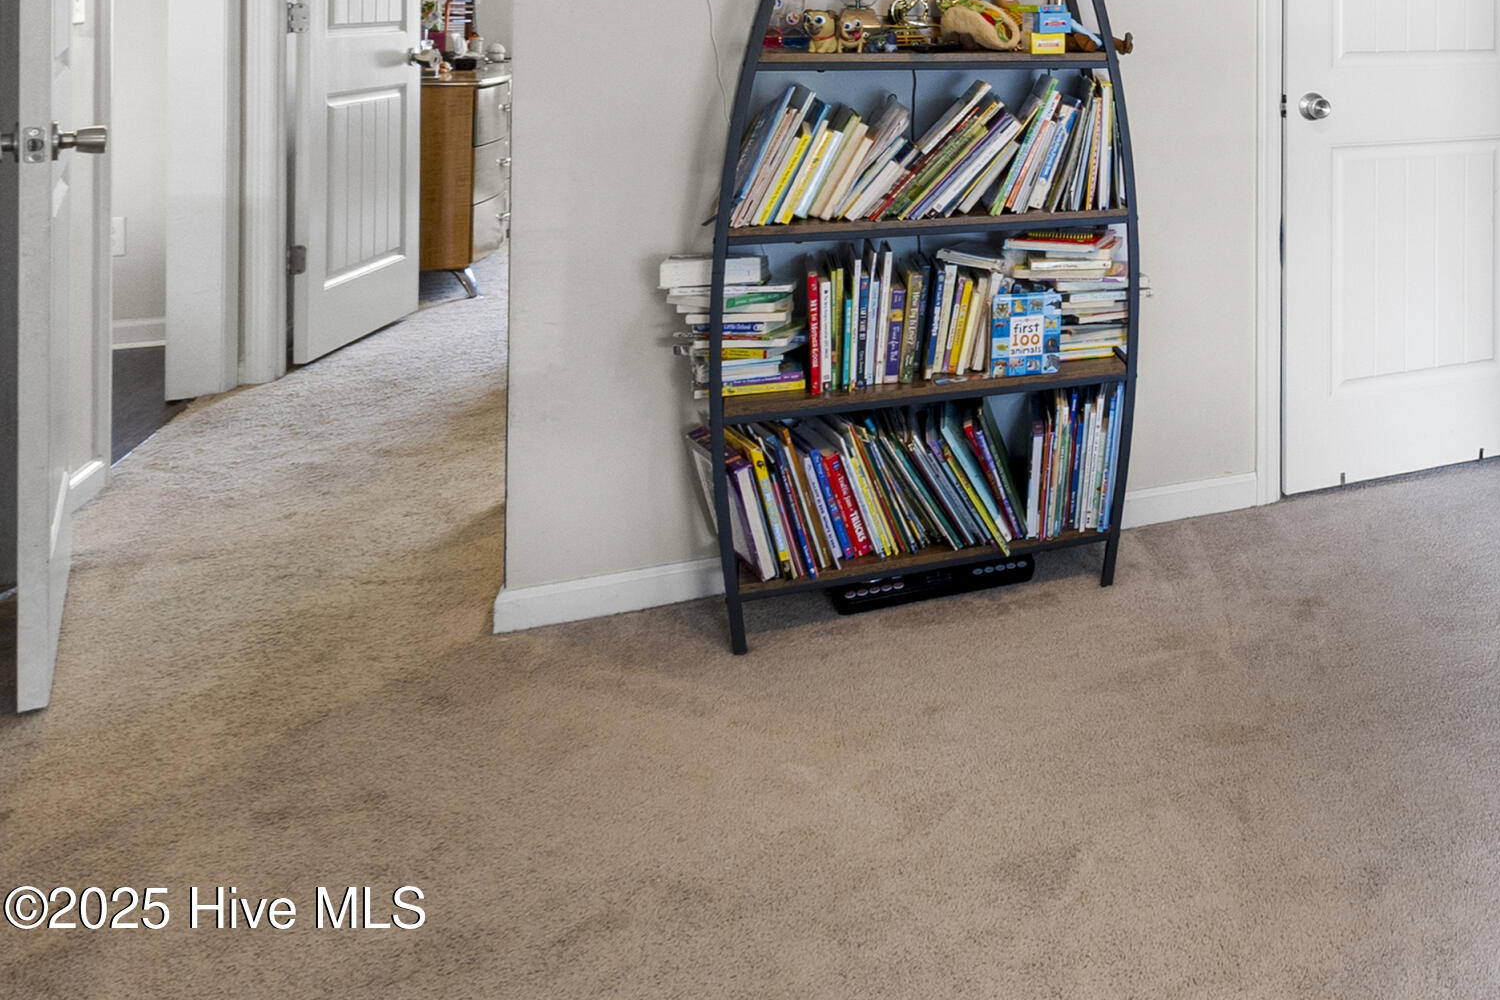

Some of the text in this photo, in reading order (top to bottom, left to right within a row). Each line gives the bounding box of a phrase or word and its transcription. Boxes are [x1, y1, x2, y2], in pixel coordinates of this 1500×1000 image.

[1013, 322, 1040, 334] first
[1012, 333, 1041, 347] 100
[1010, 346, 1042, 355] animals
[837, 475, 850, 496] Traffic
[849, 511, 867, 543] TRUCKS
